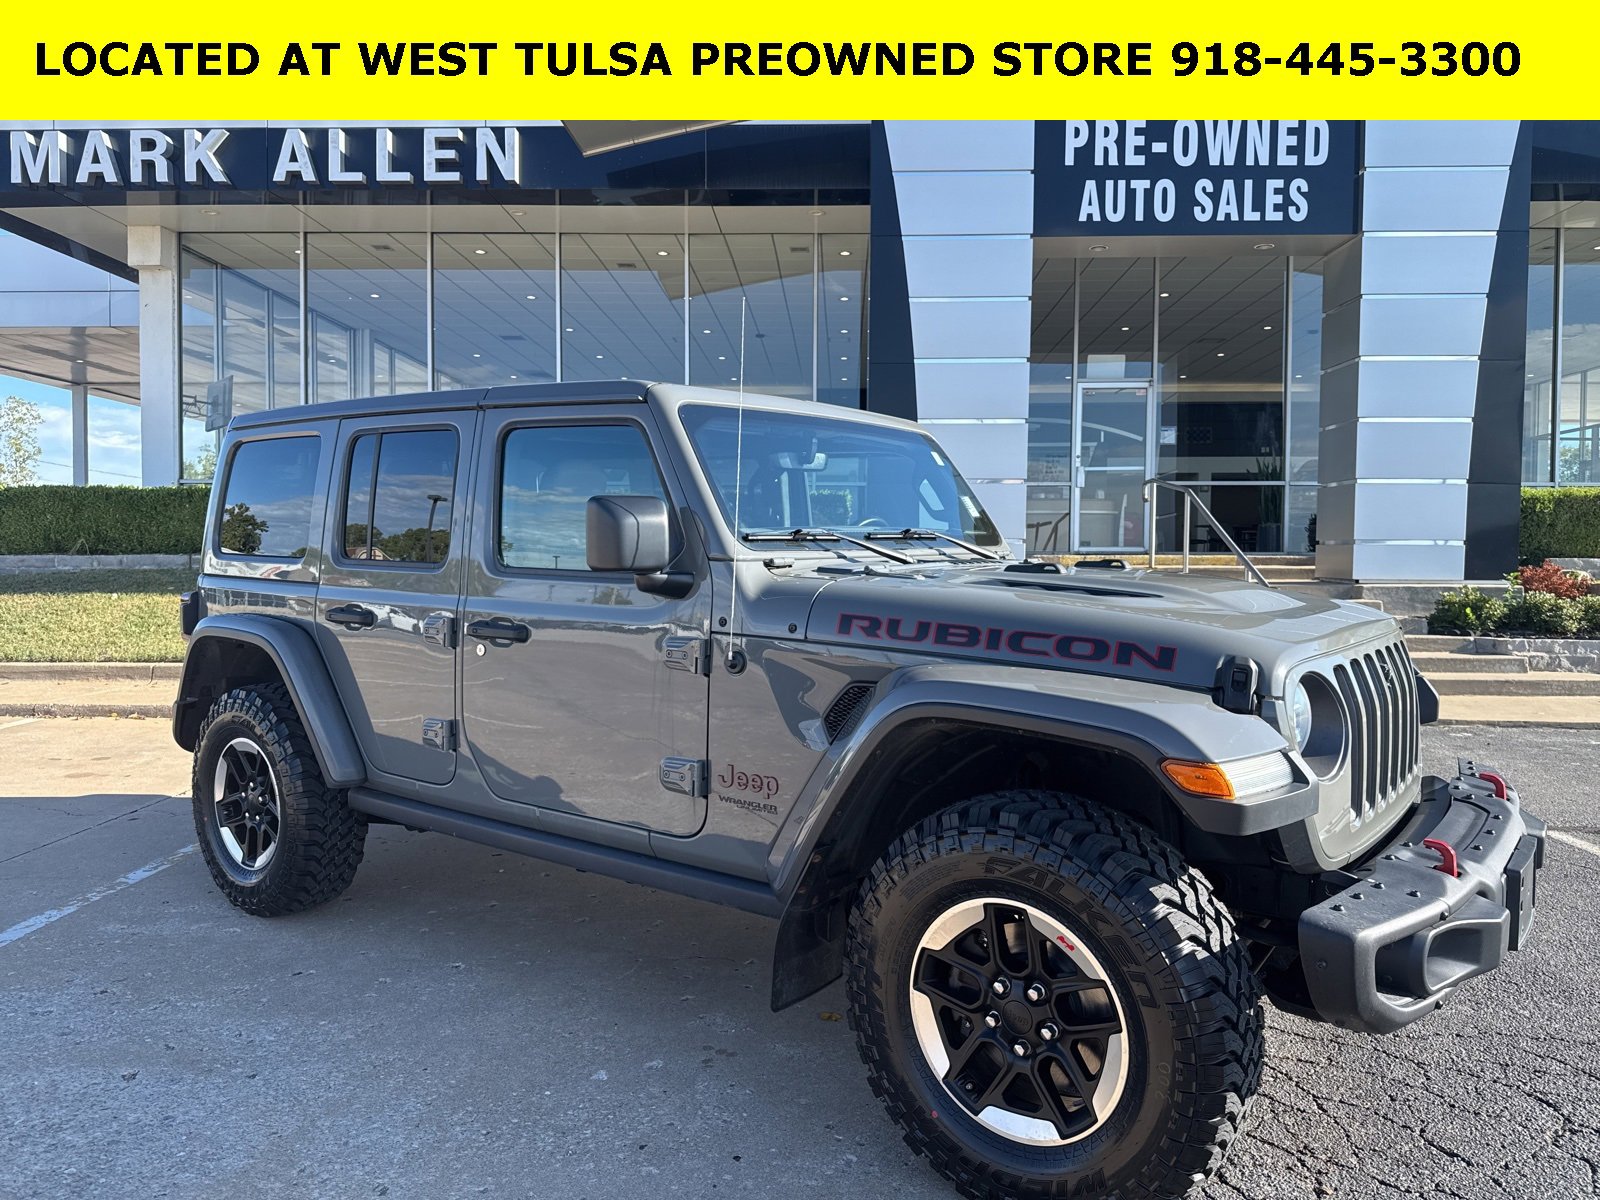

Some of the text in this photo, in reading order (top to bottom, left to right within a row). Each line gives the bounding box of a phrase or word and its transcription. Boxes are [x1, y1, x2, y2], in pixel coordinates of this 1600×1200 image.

[10, 127, 520, 187] MARK ALLEN
[1064, 120, 1330, 167] PRE-OWNED
[1078, 177, 1309, 222] AUTO SALES
[837, 612, 1178, 672] RUBICON
[718, 763, 779, 800] Jeep
[718, 794, 778, 812] WRANGLER
[984, 856, 1161, 1009] FALKEN
